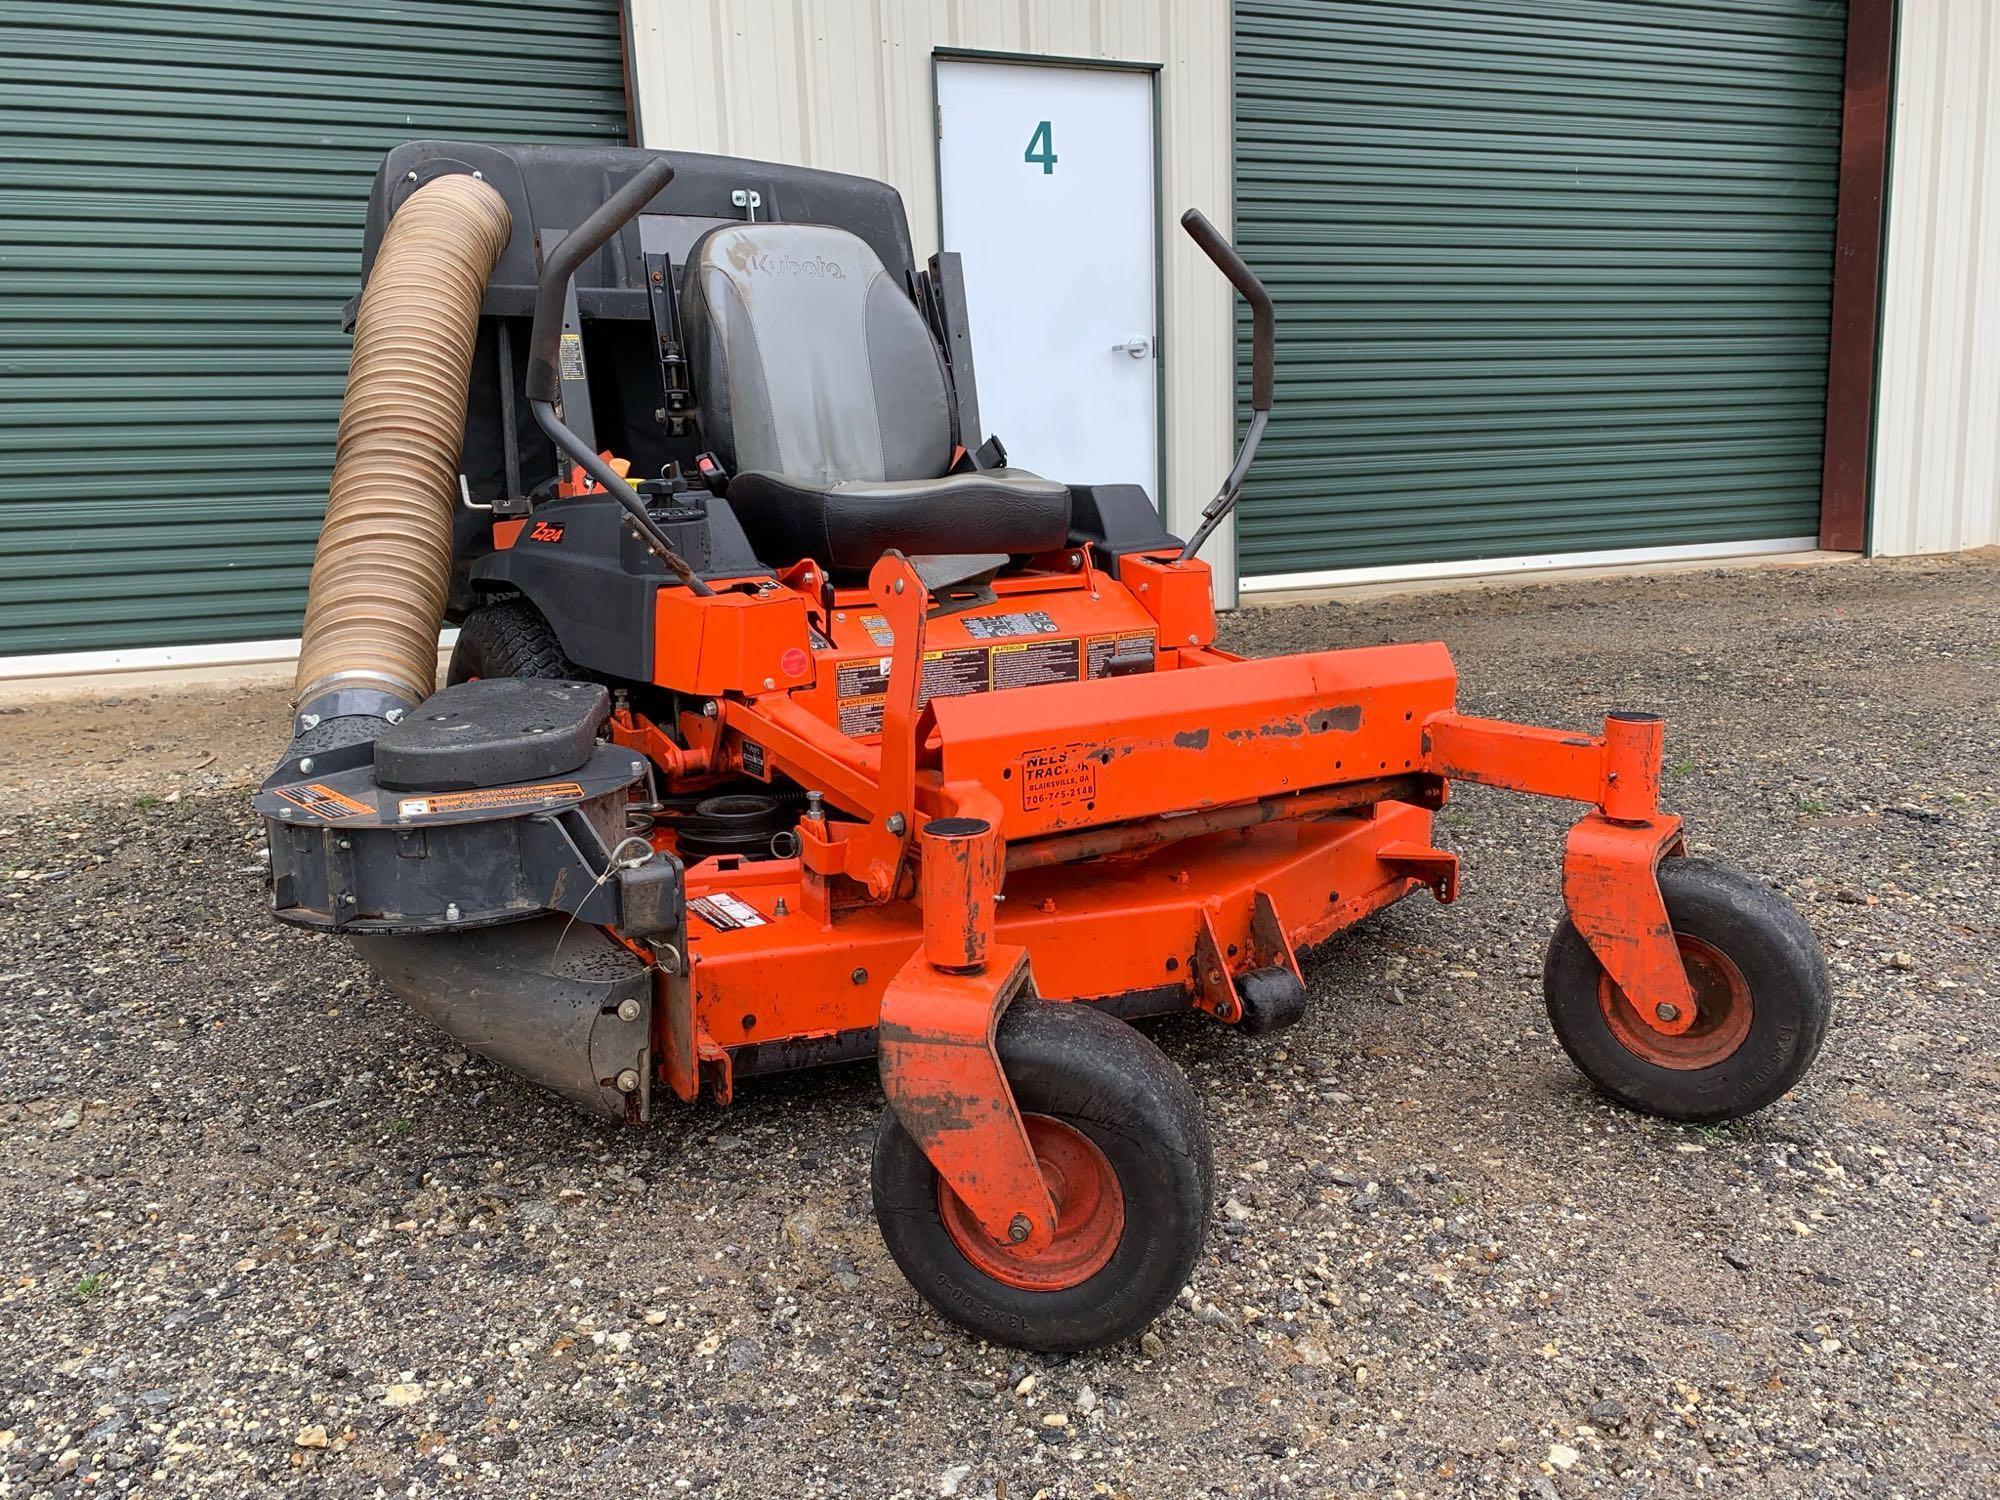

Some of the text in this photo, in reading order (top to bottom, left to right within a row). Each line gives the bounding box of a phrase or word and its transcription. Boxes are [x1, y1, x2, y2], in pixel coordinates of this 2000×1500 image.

[1024, 120, 1058, 175] 4
[751, 254, 845, 279] Kubota
[530, 521, 563, 542] Z724
[844, 659, 870, 668] WARNING
[1029, 777, 1078, 791] BLAIRSVILLE,
